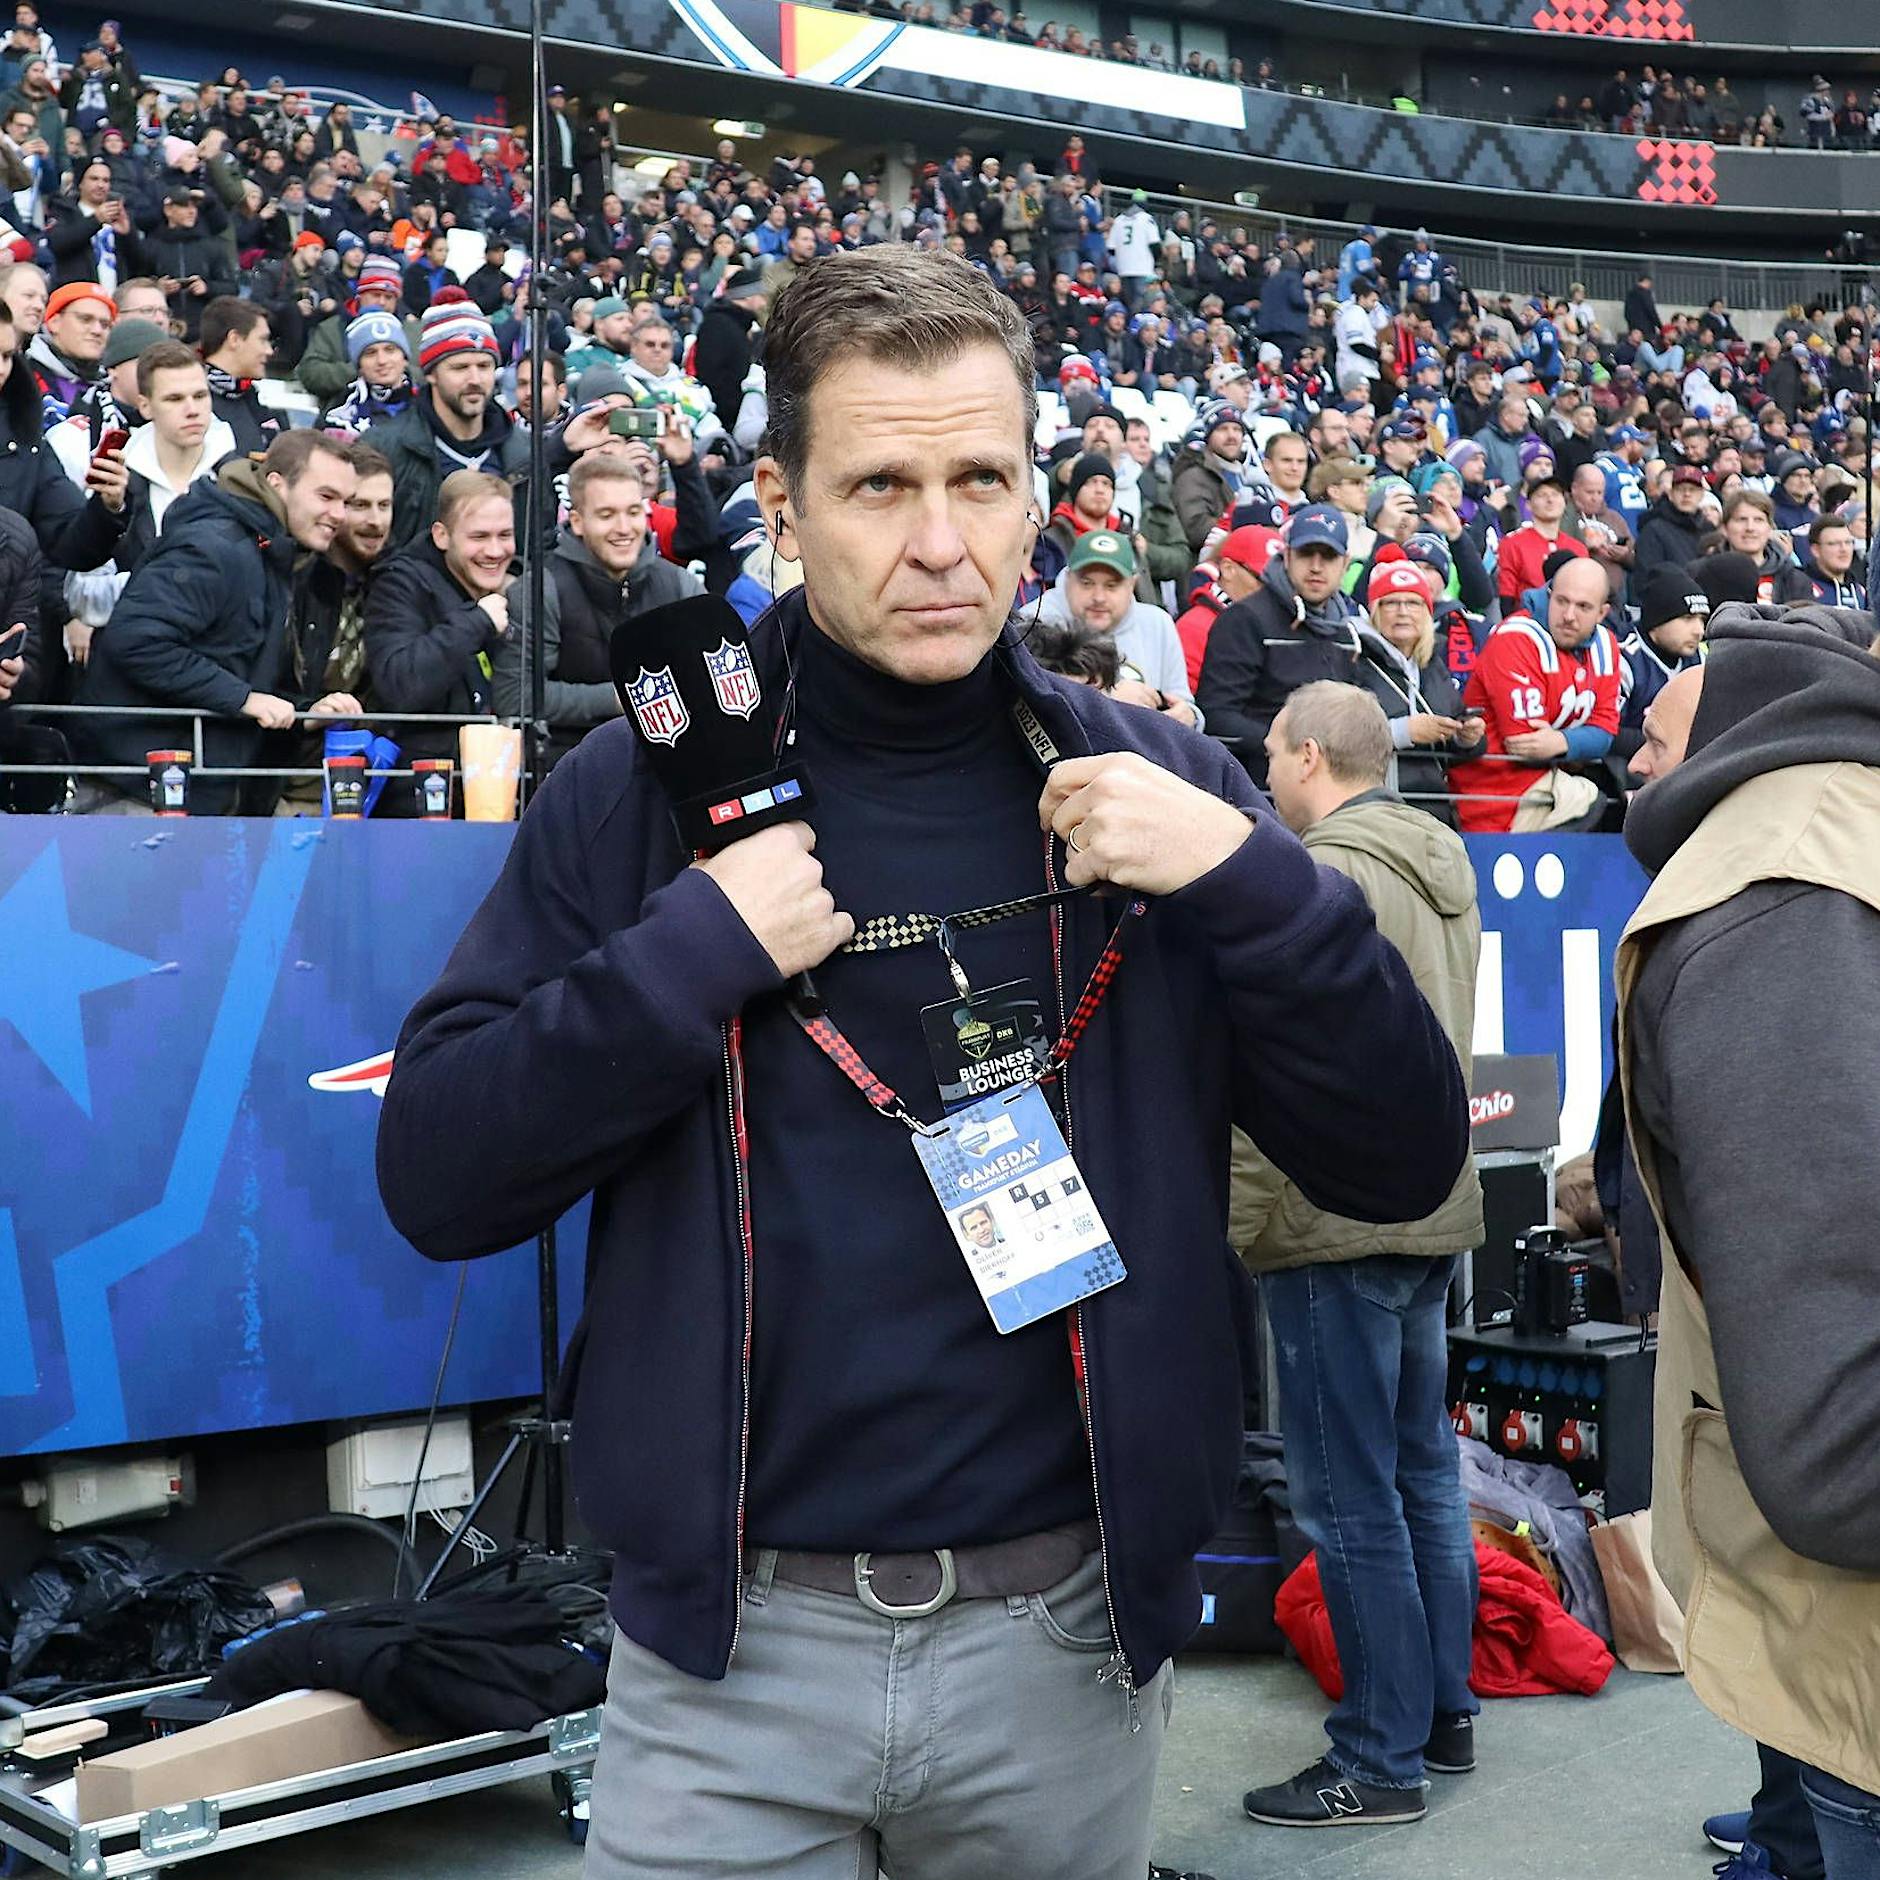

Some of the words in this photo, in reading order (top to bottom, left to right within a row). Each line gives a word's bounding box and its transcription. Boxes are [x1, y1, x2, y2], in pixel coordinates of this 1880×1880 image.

[1123, 225, 1133, 245] 3
[719, 672, 756, 706] NFL
[1510, 687, 1545, 720] 12
[640, 700, 683, 736] NFL
[1030, 730, 1053, 758] NFL
[714, 782, 798, 822] RTL
[958, 1048, 1035, 1083] BUSINESS
[966, 1064, 1035, 1096] LOUNGE
[1468, 1090, 1515, 1123] Chio
[958, 1138, 1041, 1190] GAMEDAY
[1316, 1783, 1363, 1819] N
